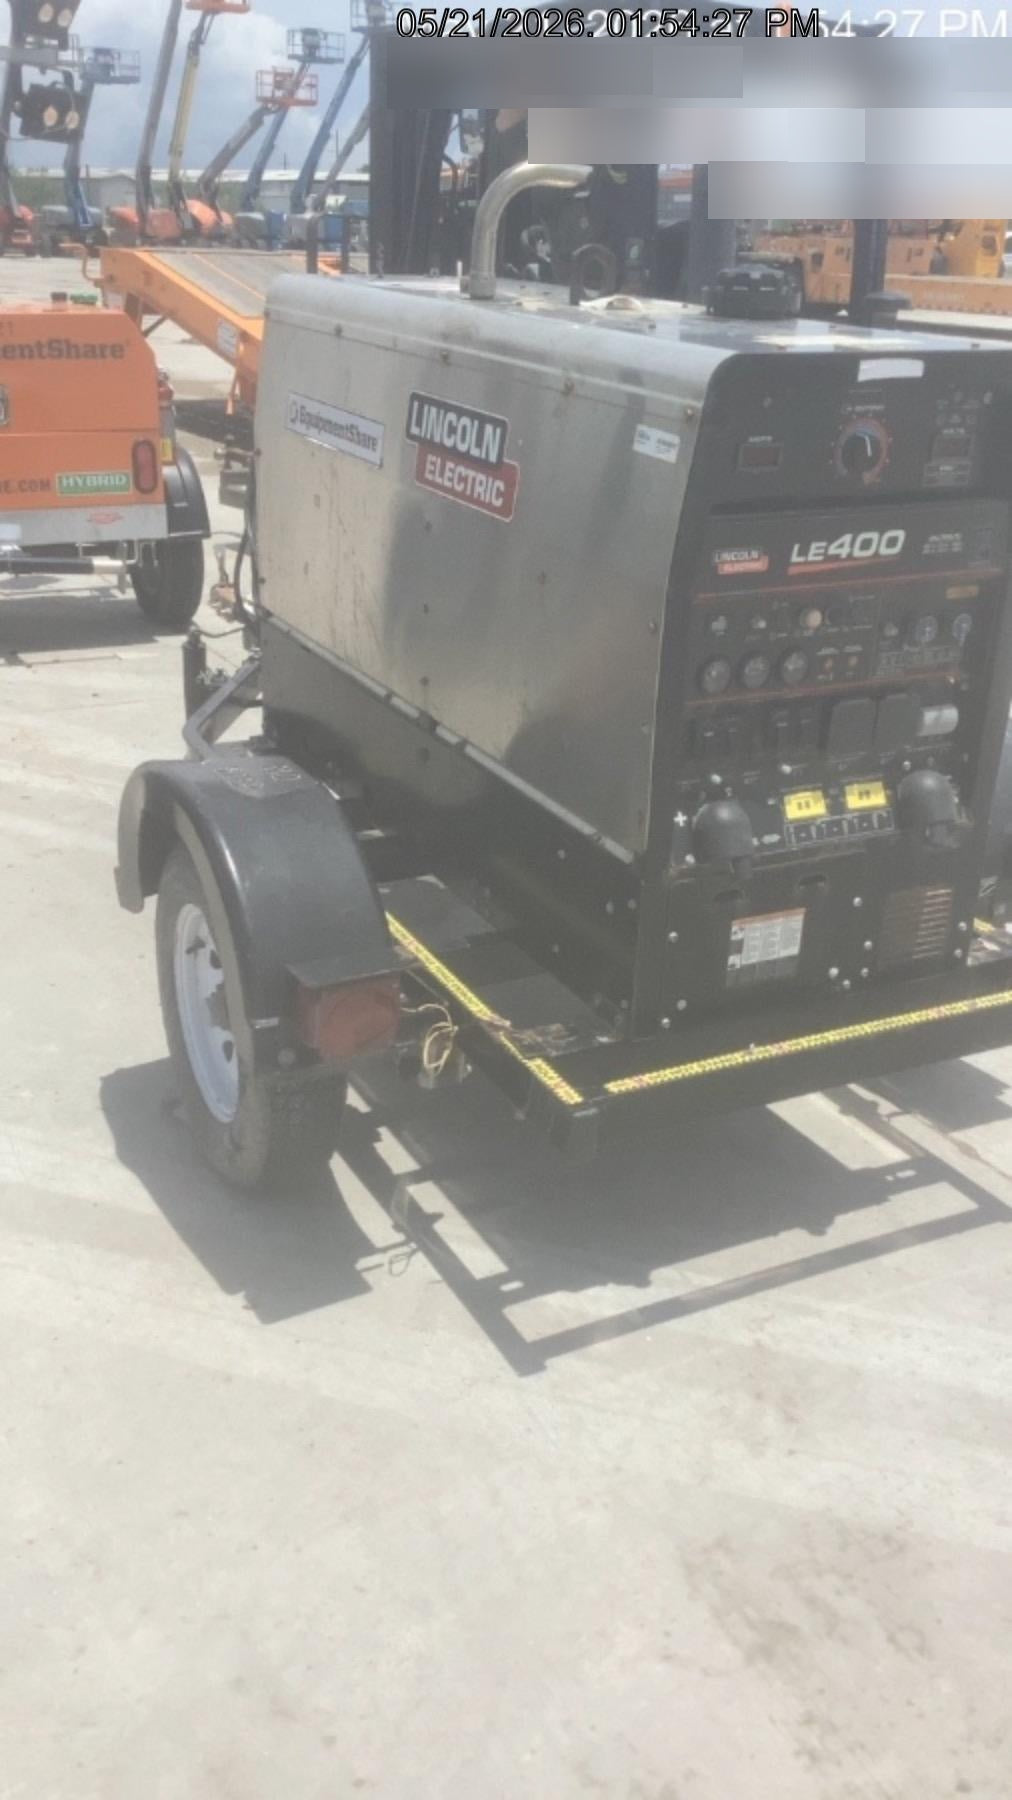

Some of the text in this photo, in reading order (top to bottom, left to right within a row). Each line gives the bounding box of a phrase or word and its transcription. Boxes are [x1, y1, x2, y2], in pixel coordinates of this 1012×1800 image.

[410, 400, 501, 463] LINCOLN
[62, 474, 128, 488] HYBRID
[424, 454, 505, 507] ELECTRIC
[790, 529, 907, 563] LE400
